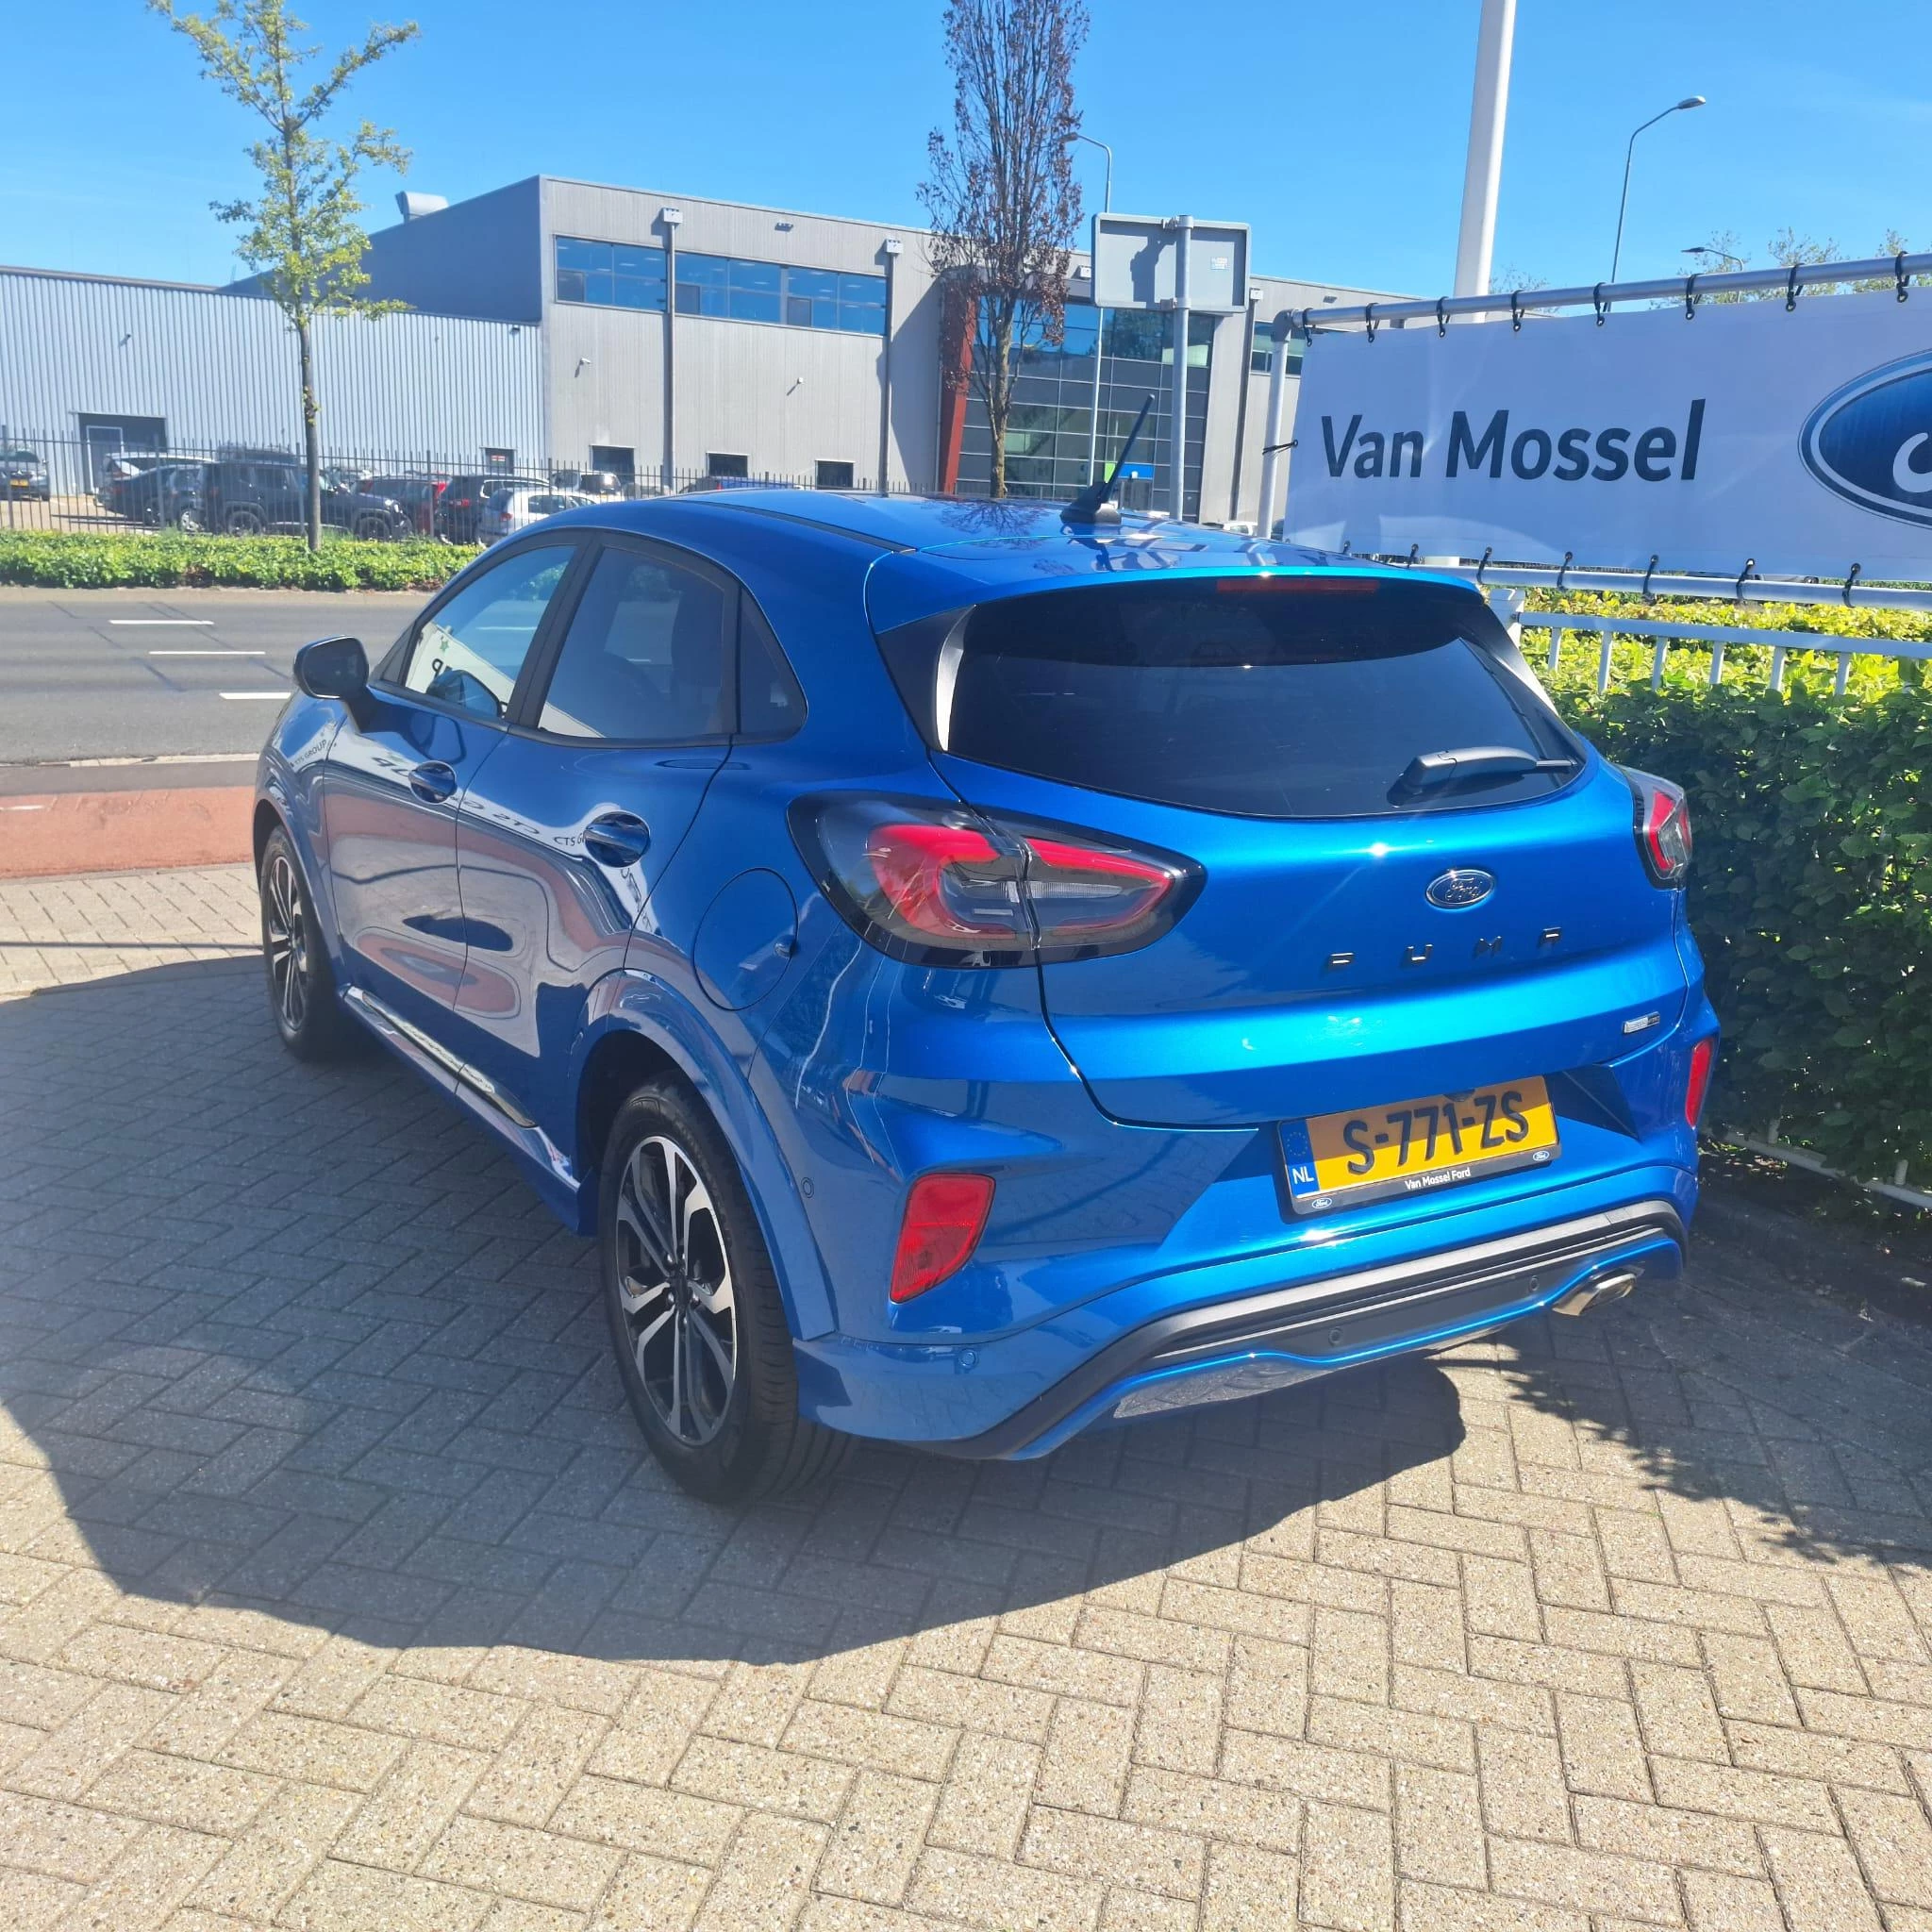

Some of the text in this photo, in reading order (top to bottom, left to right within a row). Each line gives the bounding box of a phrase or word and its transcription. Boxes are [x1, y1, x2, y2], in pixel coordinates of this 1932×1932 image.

[1321, 398, 1706, 481] Van Mossel
[1343, 1091, 1529, 1174] S-771-ZS
[1291, 1165, 1315, 1185] NL
[1405, 1167, 1472, 1190] Van Mossel Ford
